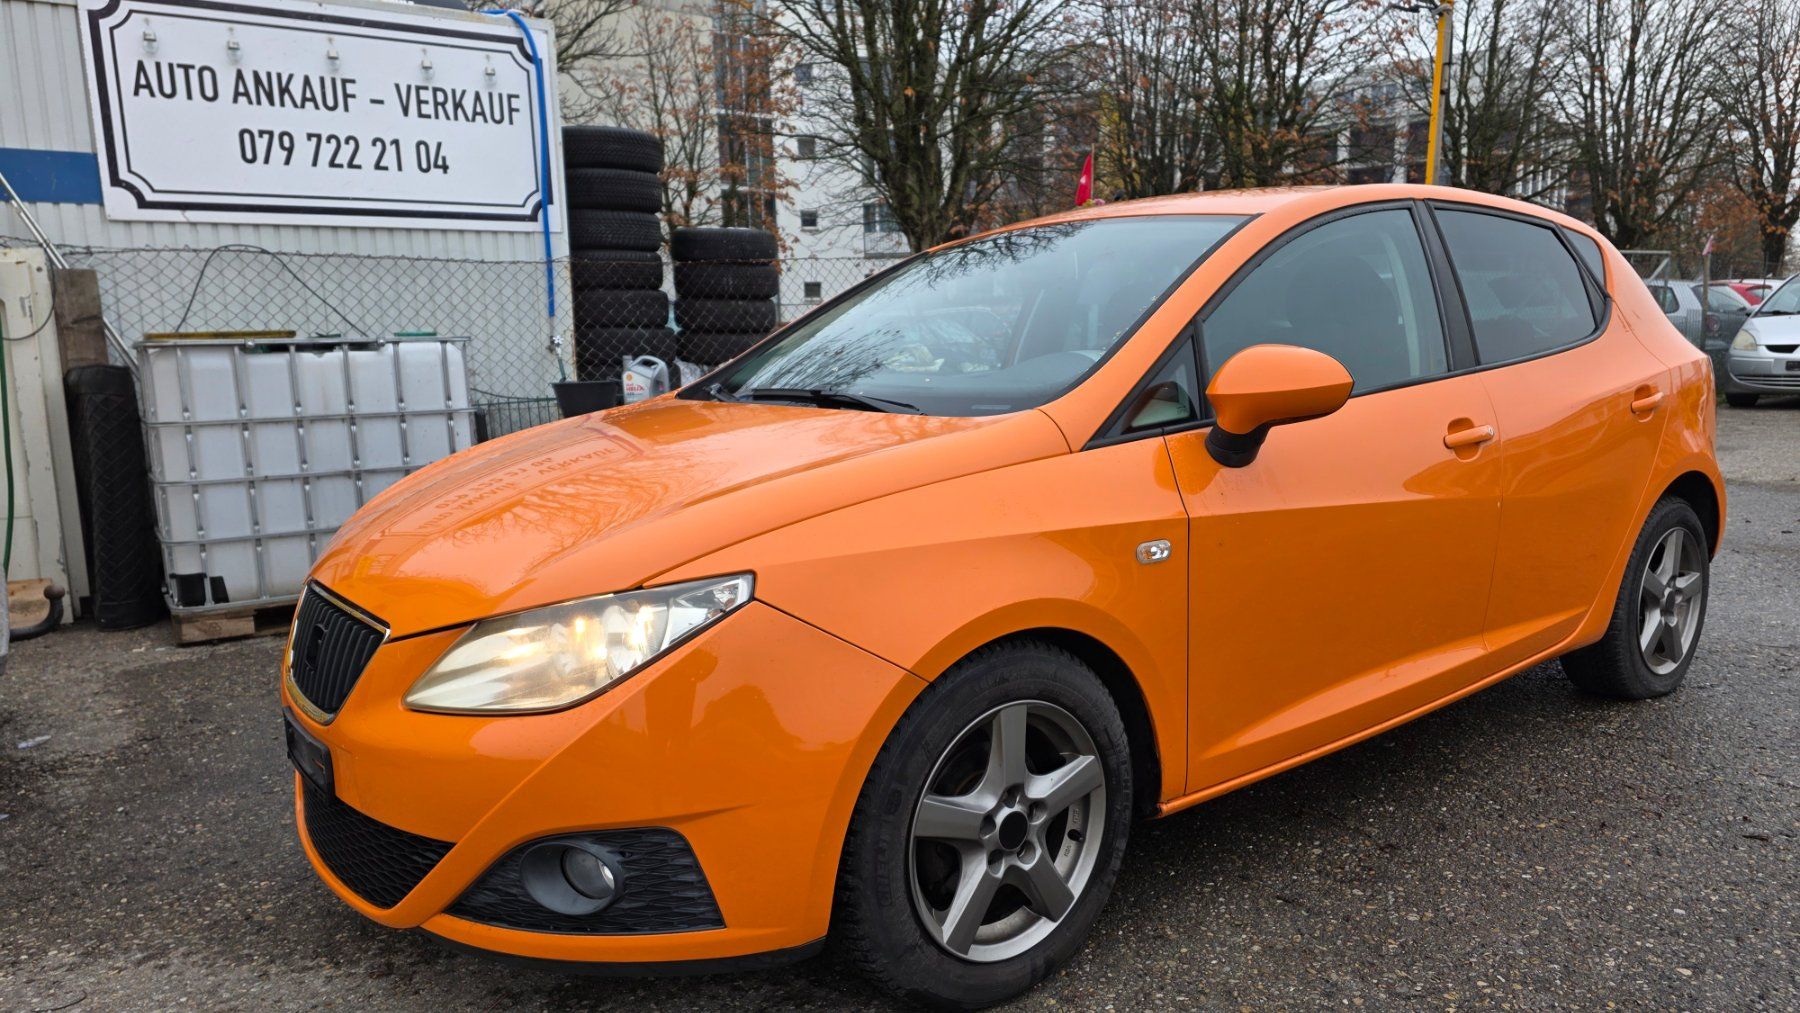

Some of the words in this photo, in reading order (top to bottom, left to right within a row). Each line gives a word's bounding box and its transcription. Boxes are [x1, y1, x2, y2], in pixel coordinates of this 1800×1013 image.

[133, 59, 219, 102] AUTO
[232, 68, 357, 113] ANKAUF
[394, 83, 521, 126] VERKAUF
[238, 128, 295, 166] 079
[306, 132, 362, 170] 722
[371, 137, 403, 172] 21
[415, 140, 450, 175] 04
